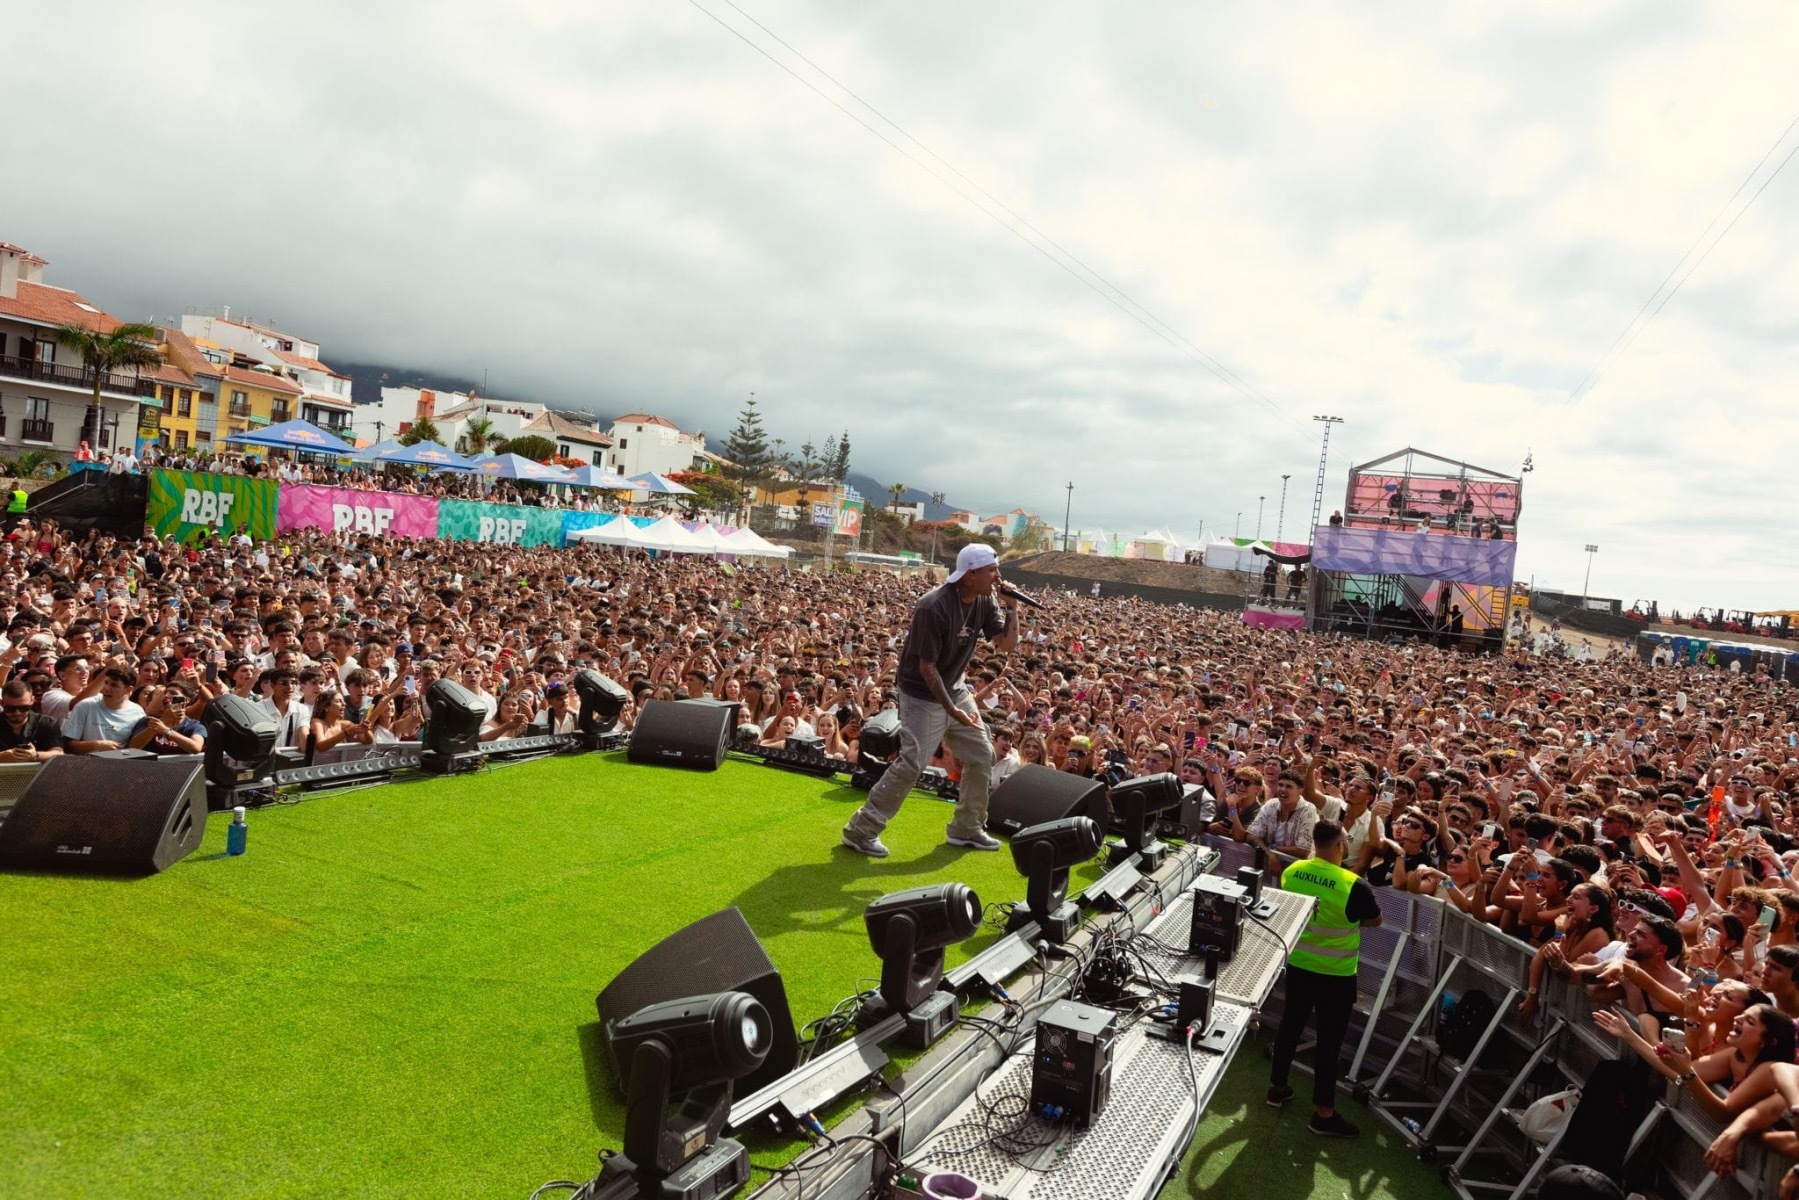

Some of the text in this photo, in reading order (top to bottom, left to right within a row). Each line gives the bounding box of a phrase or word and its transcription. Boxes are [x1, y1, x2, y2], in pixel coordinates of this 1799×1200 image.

[180, 488, 235, 527] RBF
[332, 503, 395, 538] RBF
[837, 508, 857, 528] VIP
[478, 516, 527, 548] RBF
[1293, 870, 1337, 890] AUXILIAR
